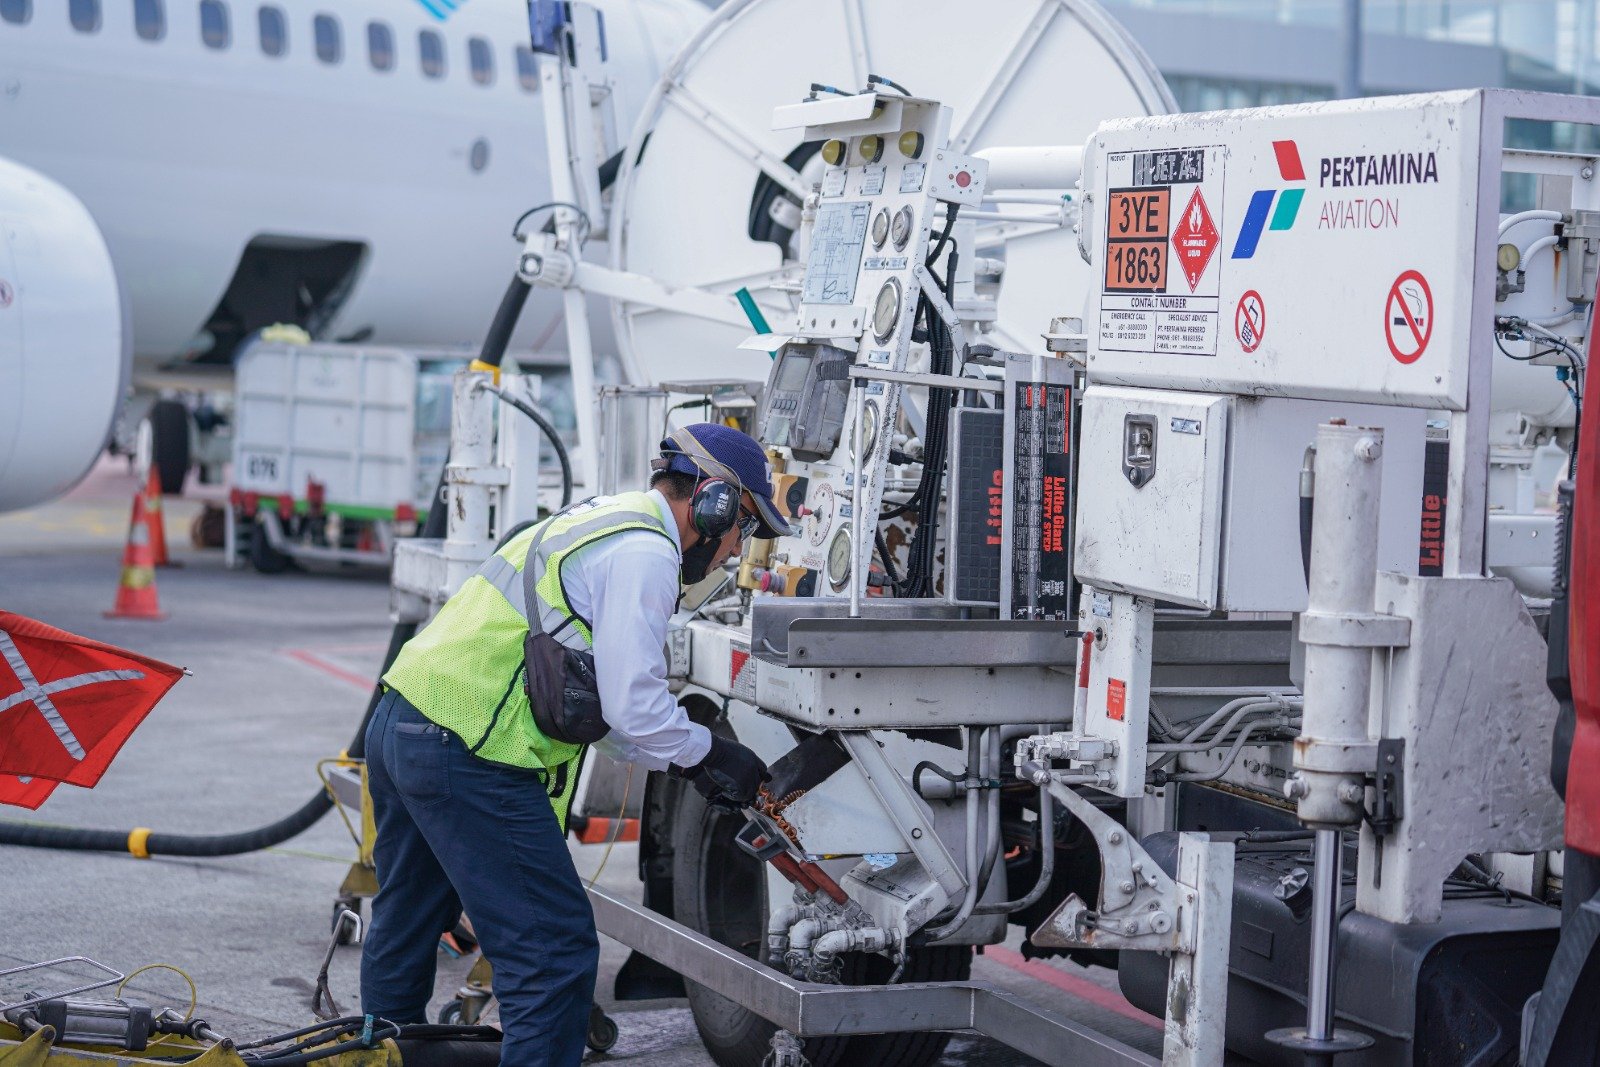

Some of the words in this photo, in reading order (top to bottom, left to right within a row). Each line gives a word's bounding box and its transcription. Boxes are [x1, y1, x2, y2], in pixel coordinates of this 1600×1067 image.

[1320, 152, 1439, 188] PERTAMINA
[1119, 195, 1160, 233] 3YE
[1318, 198, 1399, 229] AVIATION
[1114, 247, 1160, 284] 1863
[1191, 272, 1196, 285] 3
[1130, 298, 1159, 308] CONTACT
[1160, 299, 1187, 309] NUMBER
[1191, 314, 1208, 322] ADVICE
[1043, 475, 1053, 520] SAFETY
[1053, 476, 1066, 514] Little
[1042, 521, 1052, 552] STEP
[1053, 515, 1066, 552] Giant
[1420, 494, 1441, 567] Little
